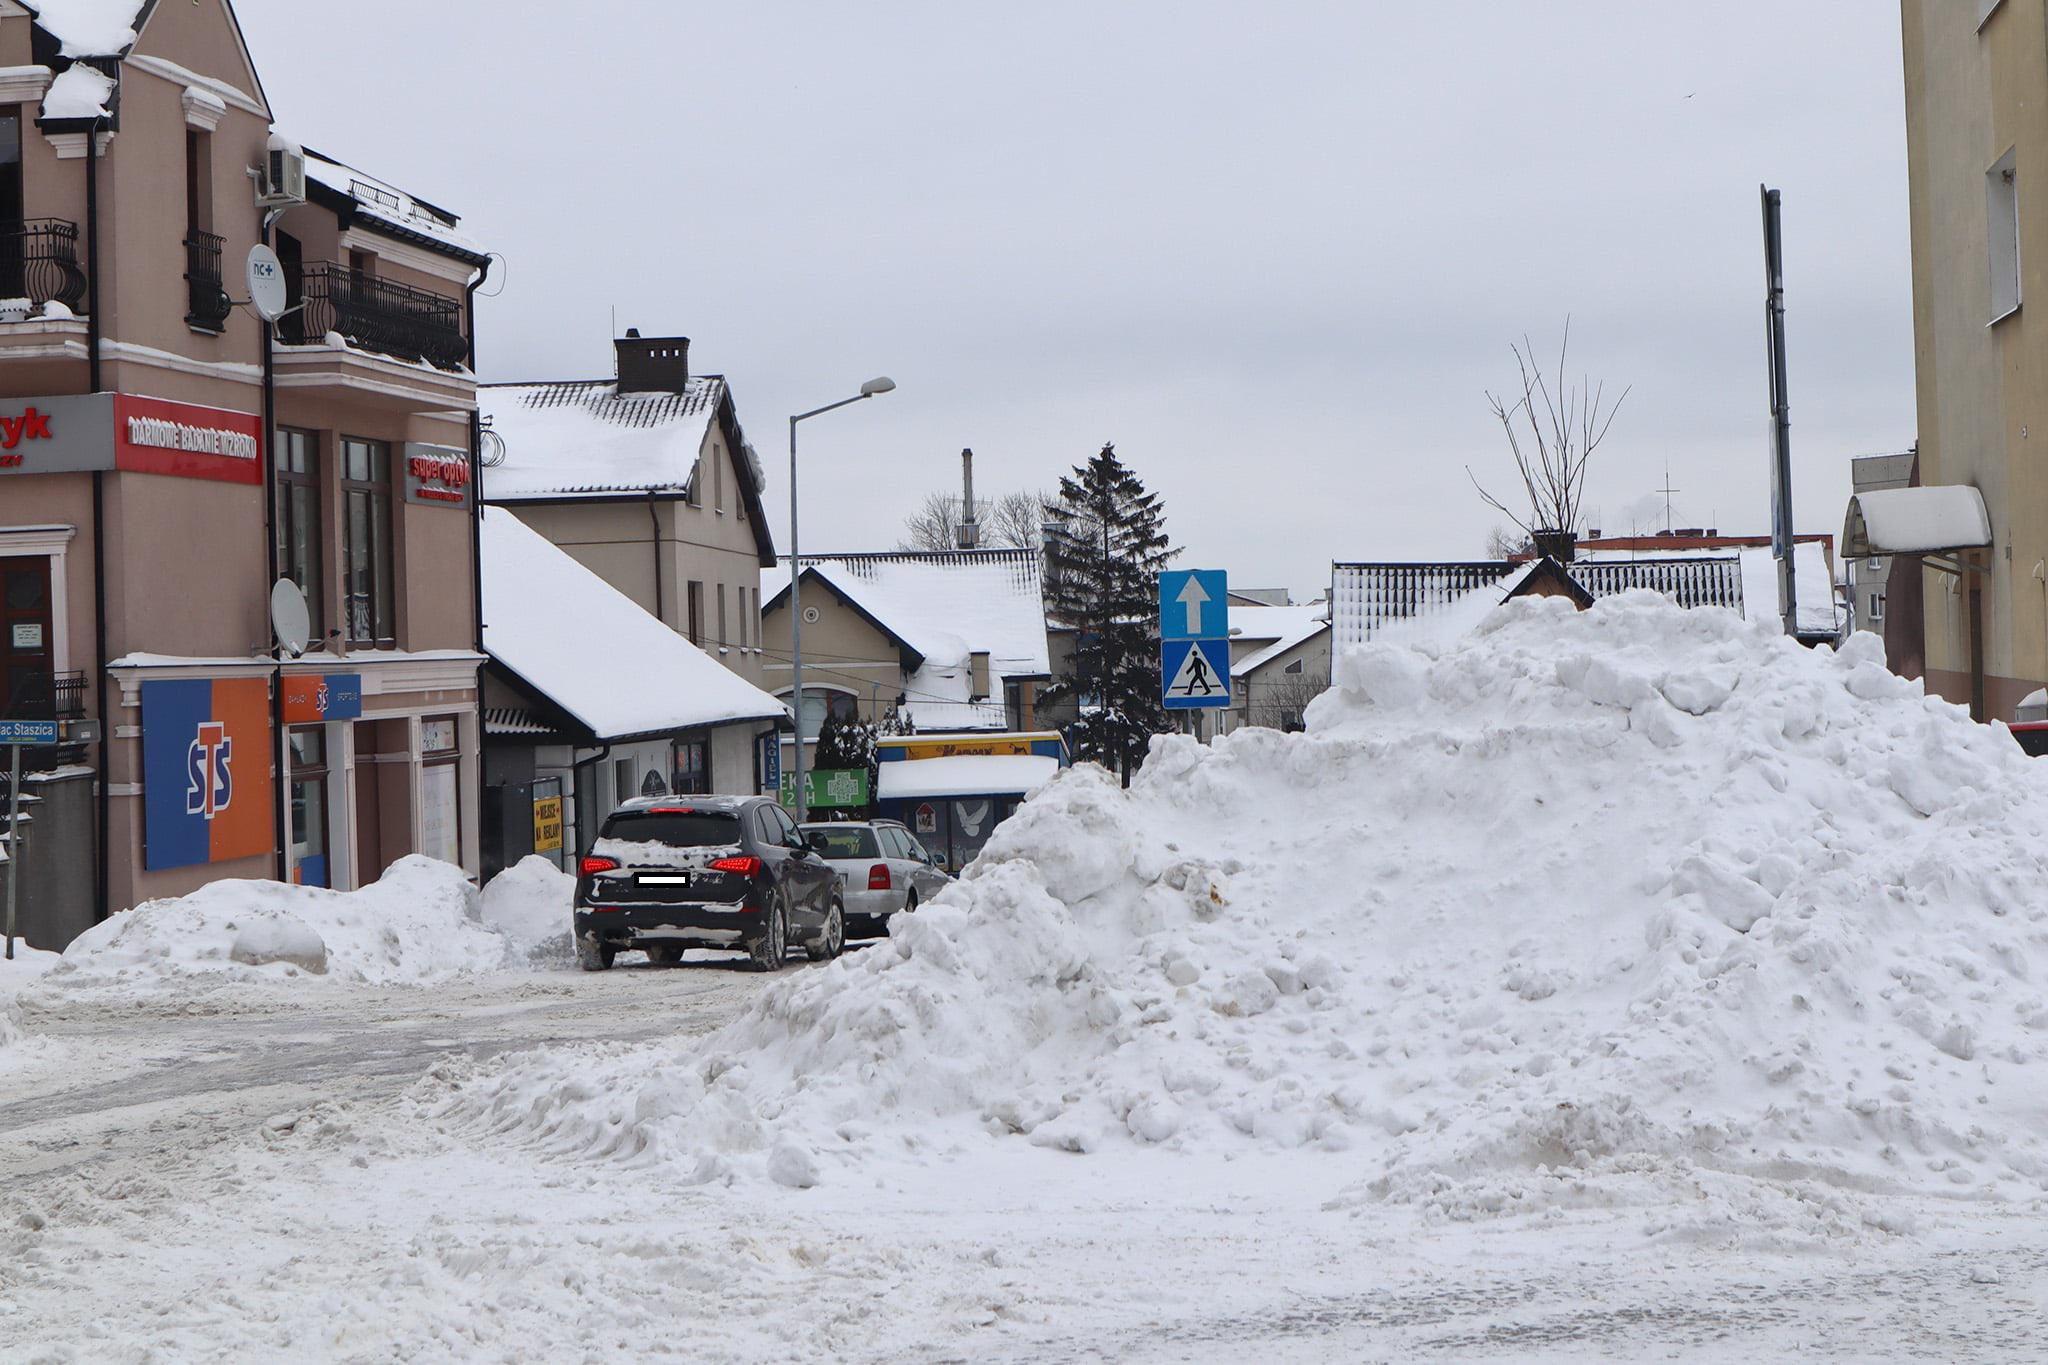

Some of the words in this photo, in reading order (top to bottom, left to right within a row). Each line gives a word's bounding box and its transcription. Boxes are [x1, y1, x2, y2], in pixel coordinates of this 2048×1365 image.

[254, 263, 273, 276] nc+
[0, 406, 53, 449] yk
[131, 418, 179, 449] DARMOWE
[181, 427, 219, 454] BADANIE
[220, 432, 257, 459] WZROKU
[410, 457, 441, 484] super
[441, 458, 470, 488] optyk
[14, 723, 53, 736] Staszica
[187, 721, 232, 820] STS
[786, 792, 816, 805] 2H
